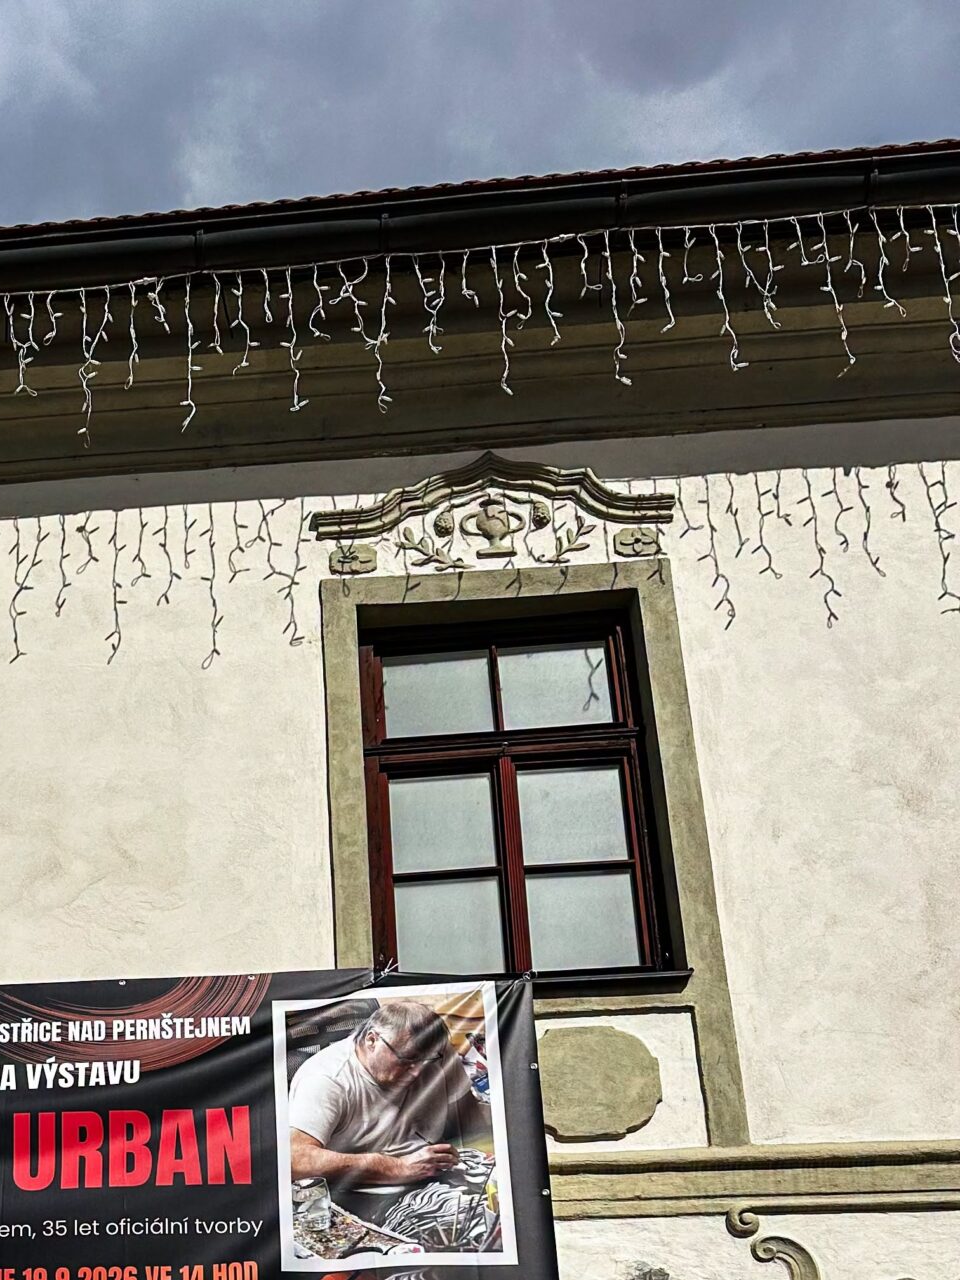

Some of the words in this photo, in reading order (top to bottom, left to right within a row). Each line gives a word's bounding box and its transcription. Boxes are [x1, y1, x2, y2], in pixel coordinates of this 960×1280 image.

[67, 1021, 106, 1042] NAD
[113, 1012, 251, 1040] PERNŠTEJNEM
[26, 1057, 141, 1088] VÝSTAVU
[11, 1104, 252, 1191] URBAN
[42, 1219, 67, 1237] 35
[73, 1218, 100, 1237] let
[105, 1215, 189, 1237] oficiální
[195, 1216, 264, 1239] tvorby
